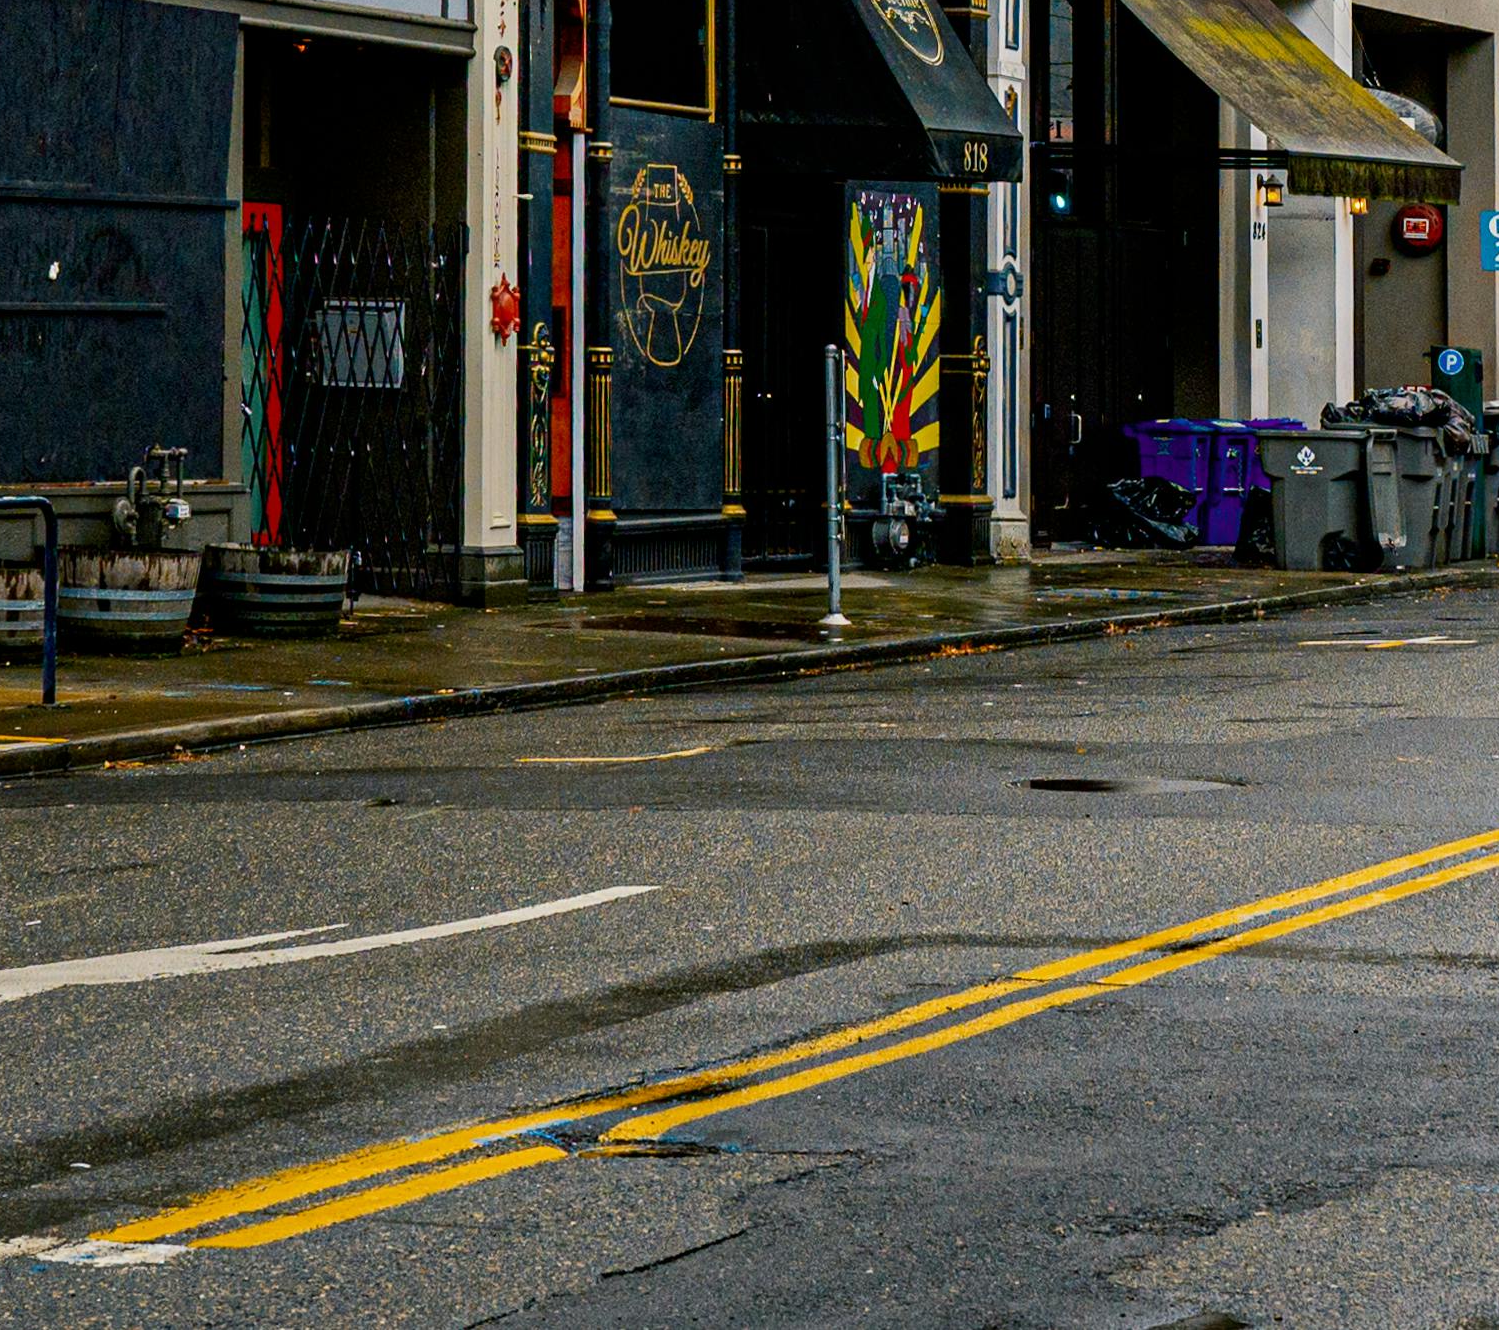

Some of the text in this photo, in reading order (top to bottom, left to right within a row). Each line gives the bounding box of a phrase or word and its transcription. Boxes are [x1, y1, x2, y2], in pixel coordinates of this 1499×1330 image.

[963, 141, 988, 173] 818
[653, 183, 672, 199] THE
[617, 204, 712, 288] Whiskey
[1446, 354, 1458, 371] P
